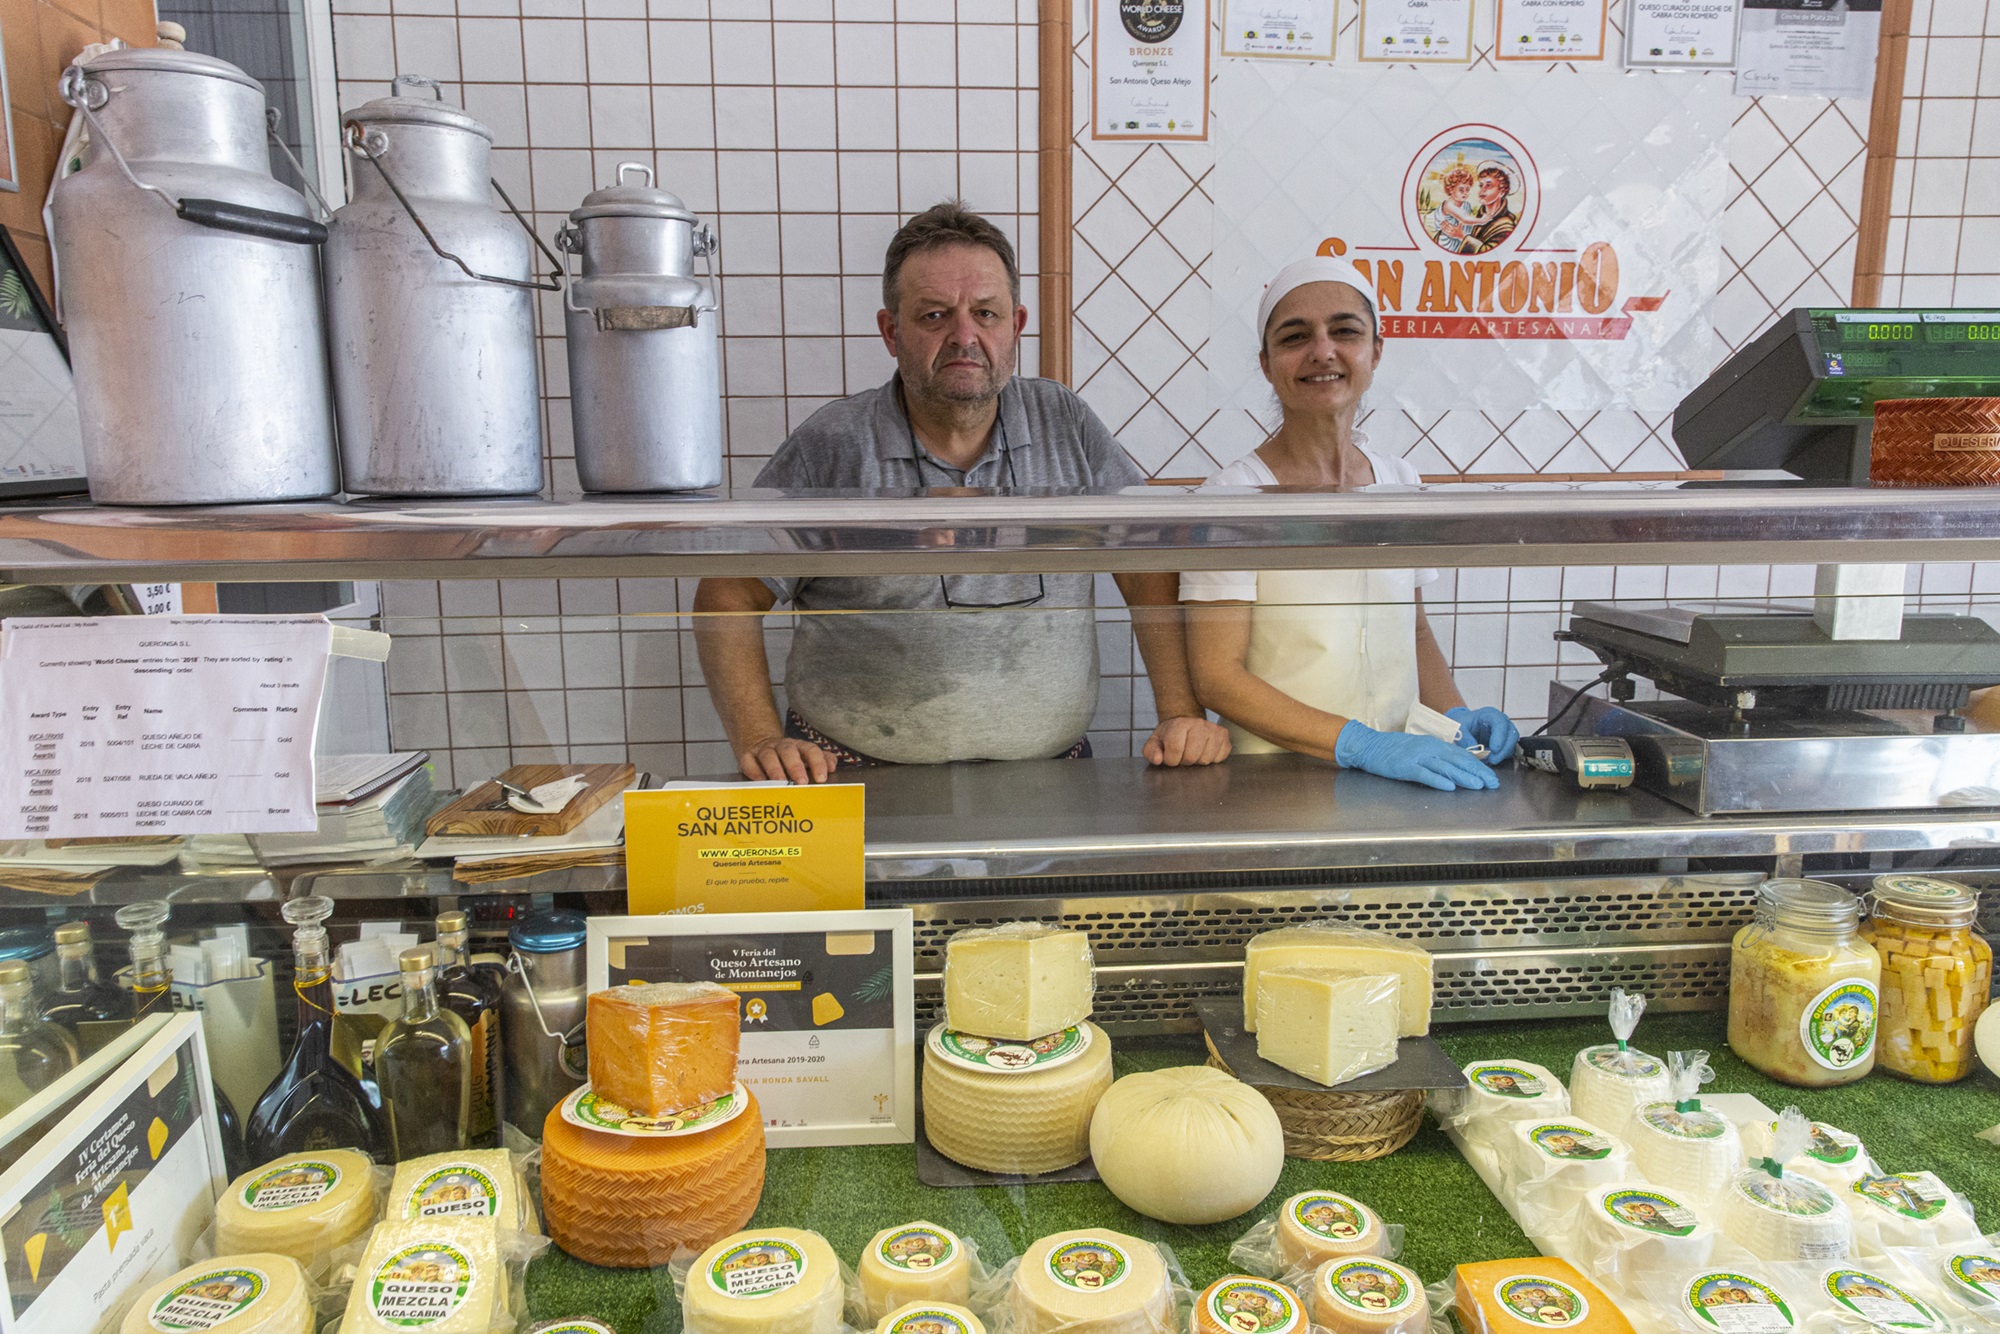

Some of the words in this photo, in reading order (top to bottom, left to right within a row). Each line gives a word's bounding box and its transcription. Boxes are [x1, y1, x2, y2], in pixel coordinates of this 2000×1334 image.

[1122, 5, 1153, 13] WORLD
[1154, 5, 1183, 13] CHEESE
[1137, 24, 1166, 33] AWARDS
[1129, 47, 1174, 56] BRONZE
[1109, 77, 1121, 85] San
[1123, 77, 1149, 85] Antonio
[1151, 77, 1171, 86] Queso
[1172, 78, 1191, 87] Añejo
[1417, 241, 1620, 315] ANTONIO
[1469, 319, 1606, 336] ARTESANAL
[1869, 325, 1913, 340] 0.000
[146, 584, 164, 599] 3,50
[39, 660, 67, 668] Currently
[68, 659, 92, 667] showing
[203, 656, 218, 664] They
[252, 656, 260, 664] by
[52, 711, 67, 719] Type
[82, 705, 100, 713] Entry
[276, 706, 298, 714] Rating
[168, 732, 191, 740] AÑEJO
[696, 802, 795, 821] QUESERÍA
[677, 822, 717, 837] SAN
[723, 819, 814, 835] ANTONIO
[700, 847, 800, 858] WWW.QUERONSA.ES
[748, 859, 782, 867] Artesana
[738, 878, 767, 886] prueba,
[768, 877, 790, 885] repite
[732, 949, 739, 957] V
[740, 948, 761, 957] Feria
[762, 948, 776, 956] del
[710, 958, 747, 970] Queso
[749, 957, 801, 967] Artesano
[715, 971, 726, 979] de
[728, 967, 797, 980] Montanejos
[1813, 988, 1844, 1020] QUESERIA
[1846, 985, 1862, 993] SAN
[751, 1057, 786, 1065] Artesana
[787, 1056, 826, 1064] 2019-2020
[1553, 1125, 1591, 1136] ANTONIO
[78, 1147, 89, 1166] IV
[90, 1113, 129, 1154] Certamen
[74, 1159, 97, 1186] Feria
[97, 1141, 111, 1162] del
[111, 1120, 136, 1149] Queso
[91, 1144, 127, 1186] Artesano
[81, 1194, 94, 1210] de
[93, 1145, 139, 1198] Montanejos
[465, 1169, 495, 1199] ANTONIO
[258, 1190, 320, 1203] MEZCLA
[262, 1184, 323, 1196] QUESO
[1635, 1191, 1678, 1208] ANTONIO
[423, 1200, 485, 1216] QUESO
[746, 1241, 765, 1249] SAN
[767, 1240, 800, 1260] ANTONIO
[730, 1264, 793, 1279] QUESO
[731, 1271, 795, 1288] MEZCLA
[387, 1285, 453, 1294] QUESO
[729, 1280, 797, 1295] VACA-CABRA
[1690, 1277, 1709, 1308] QUESERIA
[1733, 1275, 1781, 1303] ANTONIO
[176, 1297, 232, 1311] QUESO
[382, 1296, 449, 1306] MEZCLA
[164, 1305, 223, 1320] MEZCLA
[377, 1310, 447, 1318] VACA-CABRA
